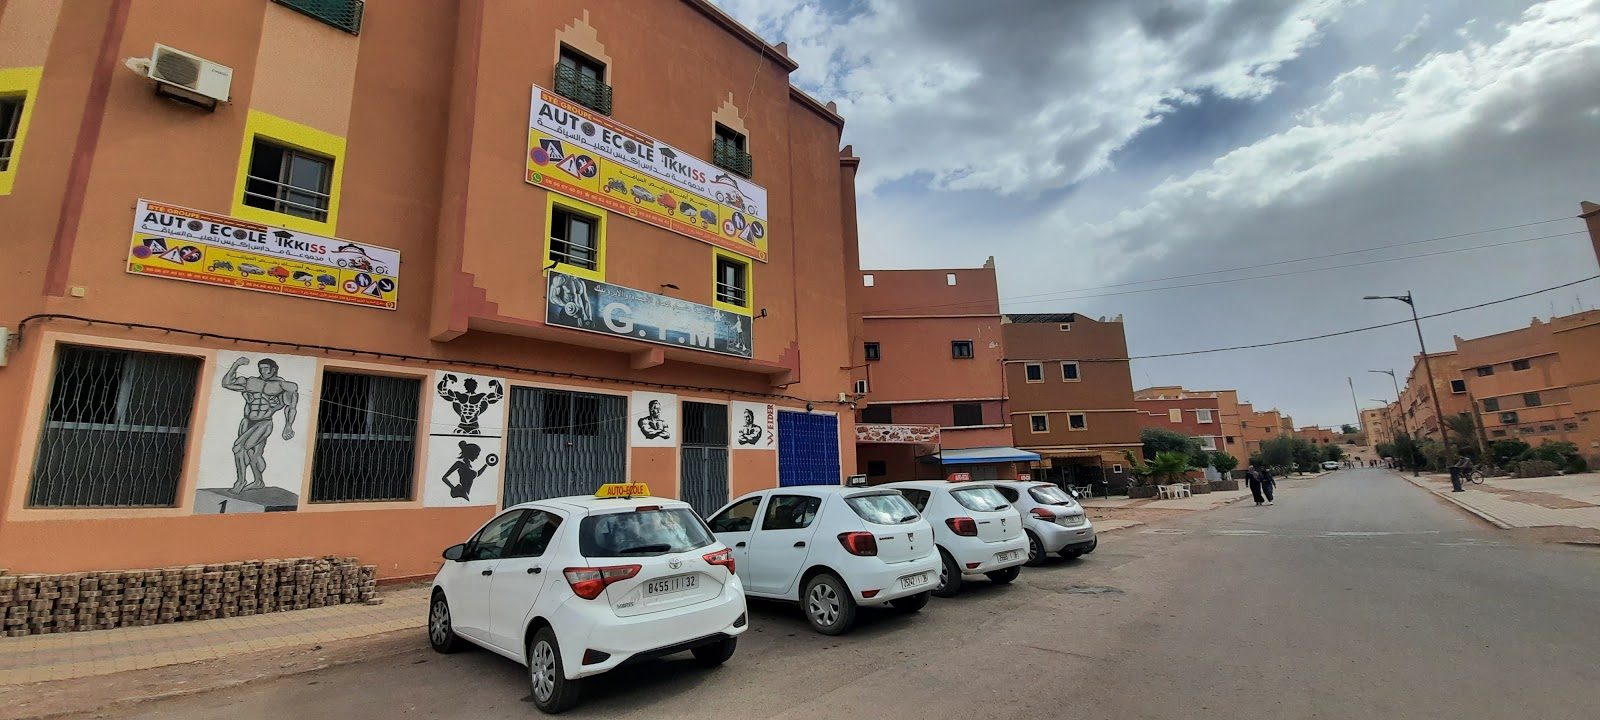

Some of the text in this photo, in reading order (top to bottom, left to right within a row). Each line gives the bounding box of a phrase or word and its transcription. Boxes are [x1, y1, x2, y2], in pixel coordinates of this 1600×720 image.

[560, 101, 593, 120] GROUPE
[664, 157, 706, 184] IKKISS
[278, 237, 327, 255] IKKISS
[608, 485, 643, 496] AUTO-ECOLE
[218, 499, 228, 514] 1
[648, 580, 669, 594] 8455
[686, 576, 695, 587] 32
